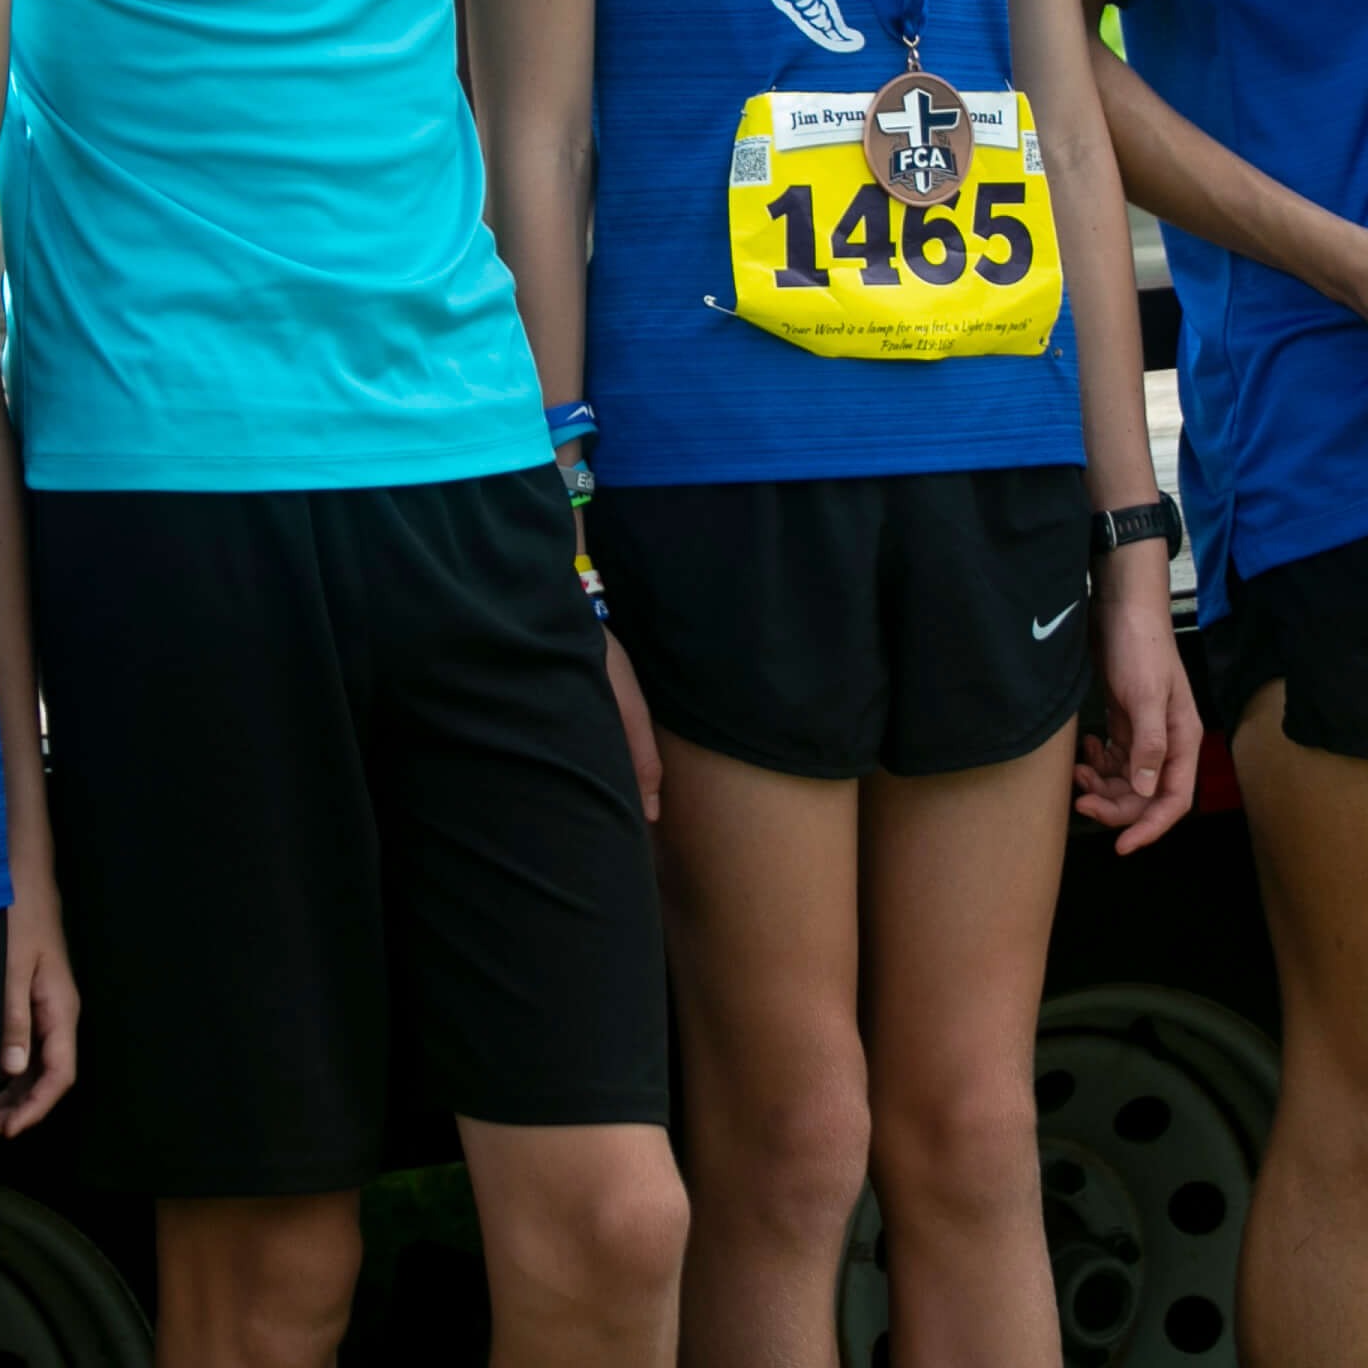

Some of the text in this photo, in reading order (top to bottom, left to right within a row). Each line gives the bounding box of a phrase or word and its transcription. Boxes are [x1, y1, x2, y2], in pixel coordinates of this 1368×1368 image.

[791, 108, 865, 130] Jim Ryun
[899, 147, 947, 172] FCA
[767, 182, 1034, 289] 1465
